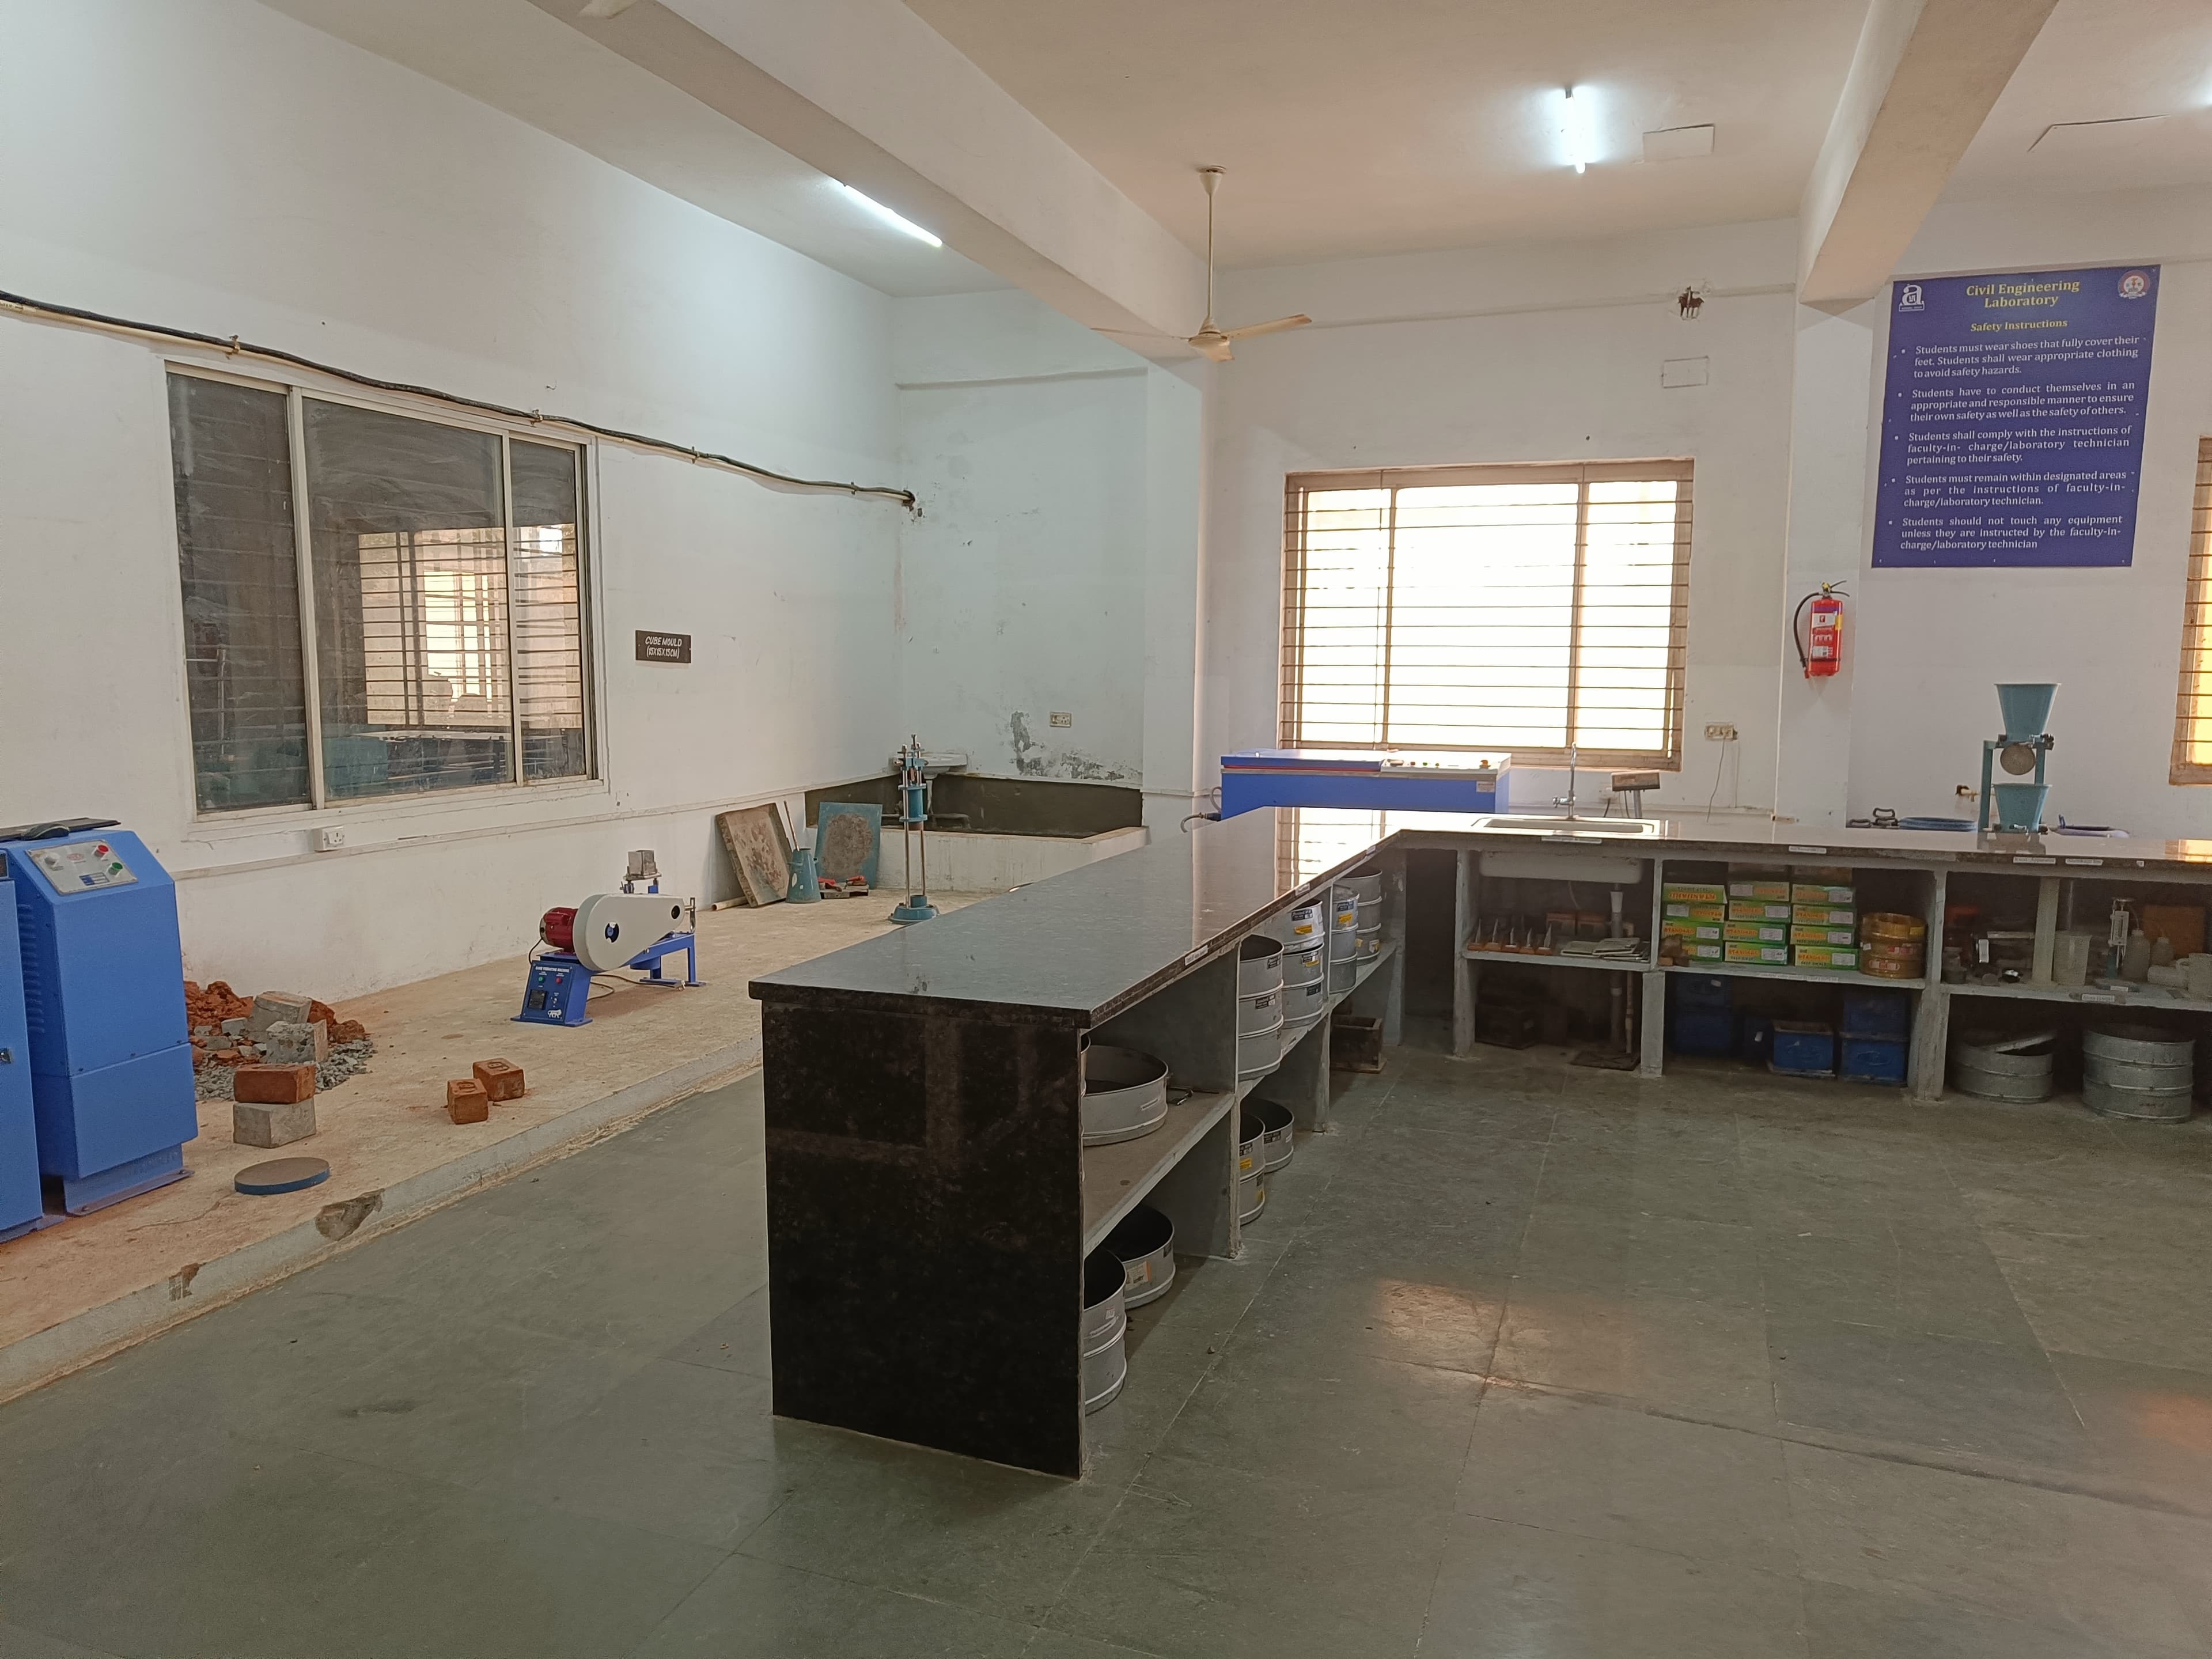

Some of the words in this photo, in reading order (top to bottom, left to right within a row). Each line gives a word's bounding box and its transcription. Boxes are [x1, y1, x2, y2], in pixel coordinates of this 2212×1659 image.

[1966, 283, 1994, 296] Civil
[1998, 280, 2080, 296] Engineering
[1984, 296, 2058, 308] Laboratory
[1970, 322, 2002, 332] Safety
[2005, 320, 2067, 329] Instructions
[1915, 344, 1957, 354] Students
[1959, 343, 1982, 352] must
[2010, 340, 2038, 350] shoes
[2040, 339, 2059, 348] that
[2061, 338, 2083, 348] fully
[2114, 335, 2139, 344] their
[1914, 357, 1934, 366] feet.
[1937, 355, 1979, 365] Students
[1982, 353, 2004, 362] shall
[2034, 351, 2093, 362] appropriate
[2096, 348, 2138, 358] clothing
[1924, 368, 1950, 377] avoid
[1951, 367, 1980, 377] safety
[1982, 365, 2021, 374] hazards.
[1912, 388, 1953, 398] Students
[1959, 387, 1981, 396] have
[2001, 384, 2040, 393] conduct
[2046, 382, 2101, 392] themselves
[2107, 381, 2116, 390] in
[1911, 400, 1967, 411] appropriate
[1968, 398, 1987, 407] and
[1988, 396, 2045, 408] responsible
[1910, 412, 1933, 421] their
[1956, 410, 1984, 421] safety
[1998, 408, 2018, 418] well
[2032, 408, 2048, 416] the
[2048, 407, 2078, 417] safety
[2080, 406, 2091, 415] of
[2091, 405, 2126, 414] others.
[1908, 431, 1950, 441] Students
[1952, 430, 1975, 440] shall
[1977, 429, 2012, 440] comply
[2014, 428, 2036, 437] with
[2040, 427, 2055, 437] the
[2058, 426, 2118, 435] instructions
[2120, 425, 2132, 434] of
[1908, 443, 1960, 453] faculty-in-
[1968, 440, 2065, 452] charge/laboratory
[2073, 438, 2129, 448] technician
[1907, 454, 1956, 466] pertaining
[1968, 453, 1991, 462] their
[1992, 452, 2022, 463] safety.
[1905, 475, 1946, 484] Students
[1974, 473, 2008, 482] remain
[2010, 472, 2041, 481] within
[2043, 470, 2097, 482] designated
[1923, 488, 1941, 497] per
[1949, 485, 1965, 494] the
[1973, 484, 2039, 494] instructions
[2047, 483, 2059, 492] of
[2066, 482, 2124, 493] faculty-in-
[1903, 497, 1990, 508] charge/laboratory
[1991, 496, 2043, 505] technician.
[1902, 517, 1943, 526] Students
[1949, 516, 1981, 525] should
[1988, 517, 2003, 525] not
[2010, 516, 2037, 525] touch
[2043, 517, 2061, 526] any
[2067, 515, 2122, 526] equipment
[1902, 529, 1931, 537] unless
[1935, 528, 1956, 539] they
[1980, 527, 2028, 536] instructed
[2033, 527, 2045, 538] by
[2050, 527, 2065, 536] the
[2070, 527, 2120, 537] faculty-in-
[1900, 540, 1987, 551] charge/laboratory
[1988, 539, 2037, 548] technician
[645, 635, 662, 645] CUBE
[662, 637, 682, 647] MOULD
